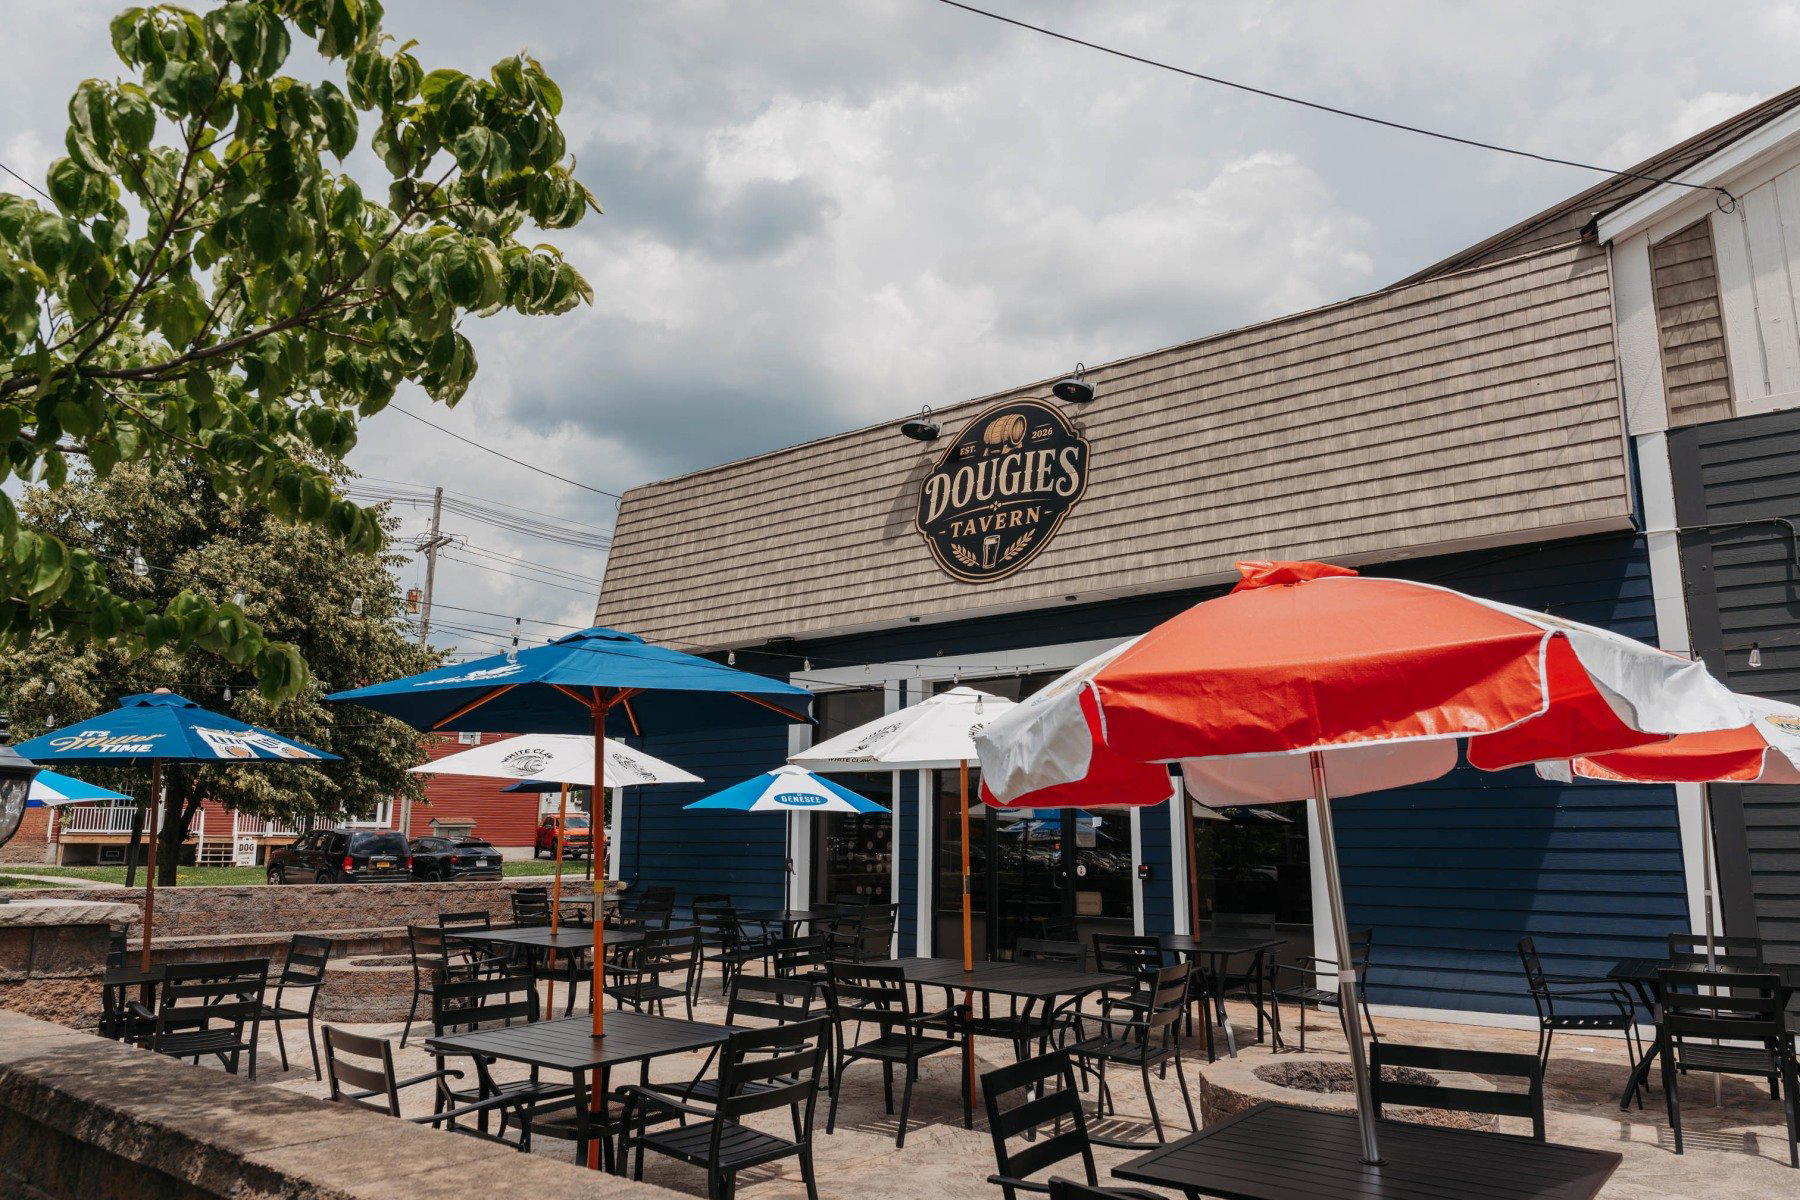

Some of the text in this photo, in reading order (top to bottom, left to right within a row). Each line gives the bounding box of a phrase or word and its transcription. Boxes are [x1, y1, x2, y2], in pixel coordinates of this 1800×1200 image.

[1031, 427, 1053, 439] 2026
[959, 445, 976, 456] EST.
[925, 446, 1080, 525] DOUGIES
[951, 506, 1042, 538] TAVERN
[49, 733, 167, 753] Miller
[99, 744, 153, 753] TIME
[501, 748, 531, 763] WHITE
[781, 795, 821, 803] GENESEE
[239, 843, 254, 851] DOG
